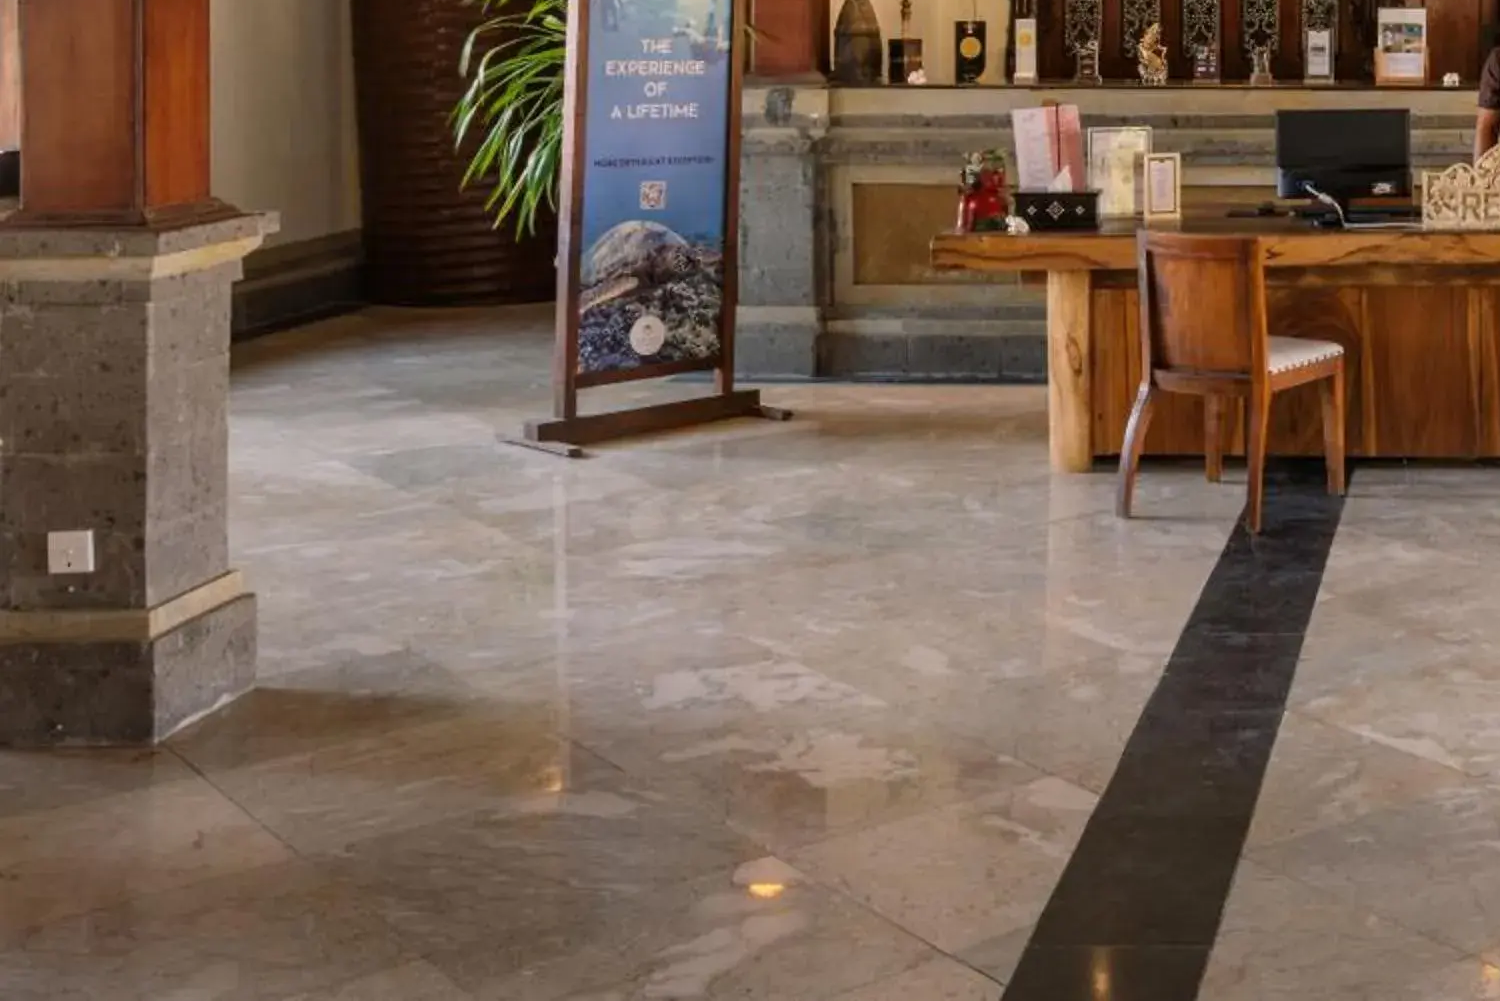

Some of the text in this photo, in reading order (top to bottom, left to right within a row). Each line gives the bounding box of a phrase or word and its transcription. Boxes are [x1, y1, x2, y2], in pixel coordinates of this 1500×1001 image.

[640, 38, 673, 54] THE
[605, 59, 705, 76] EXPERIENCE
[643, 81, 668, 98] OF
[610, 102, 698, 120] A LIFETIME
